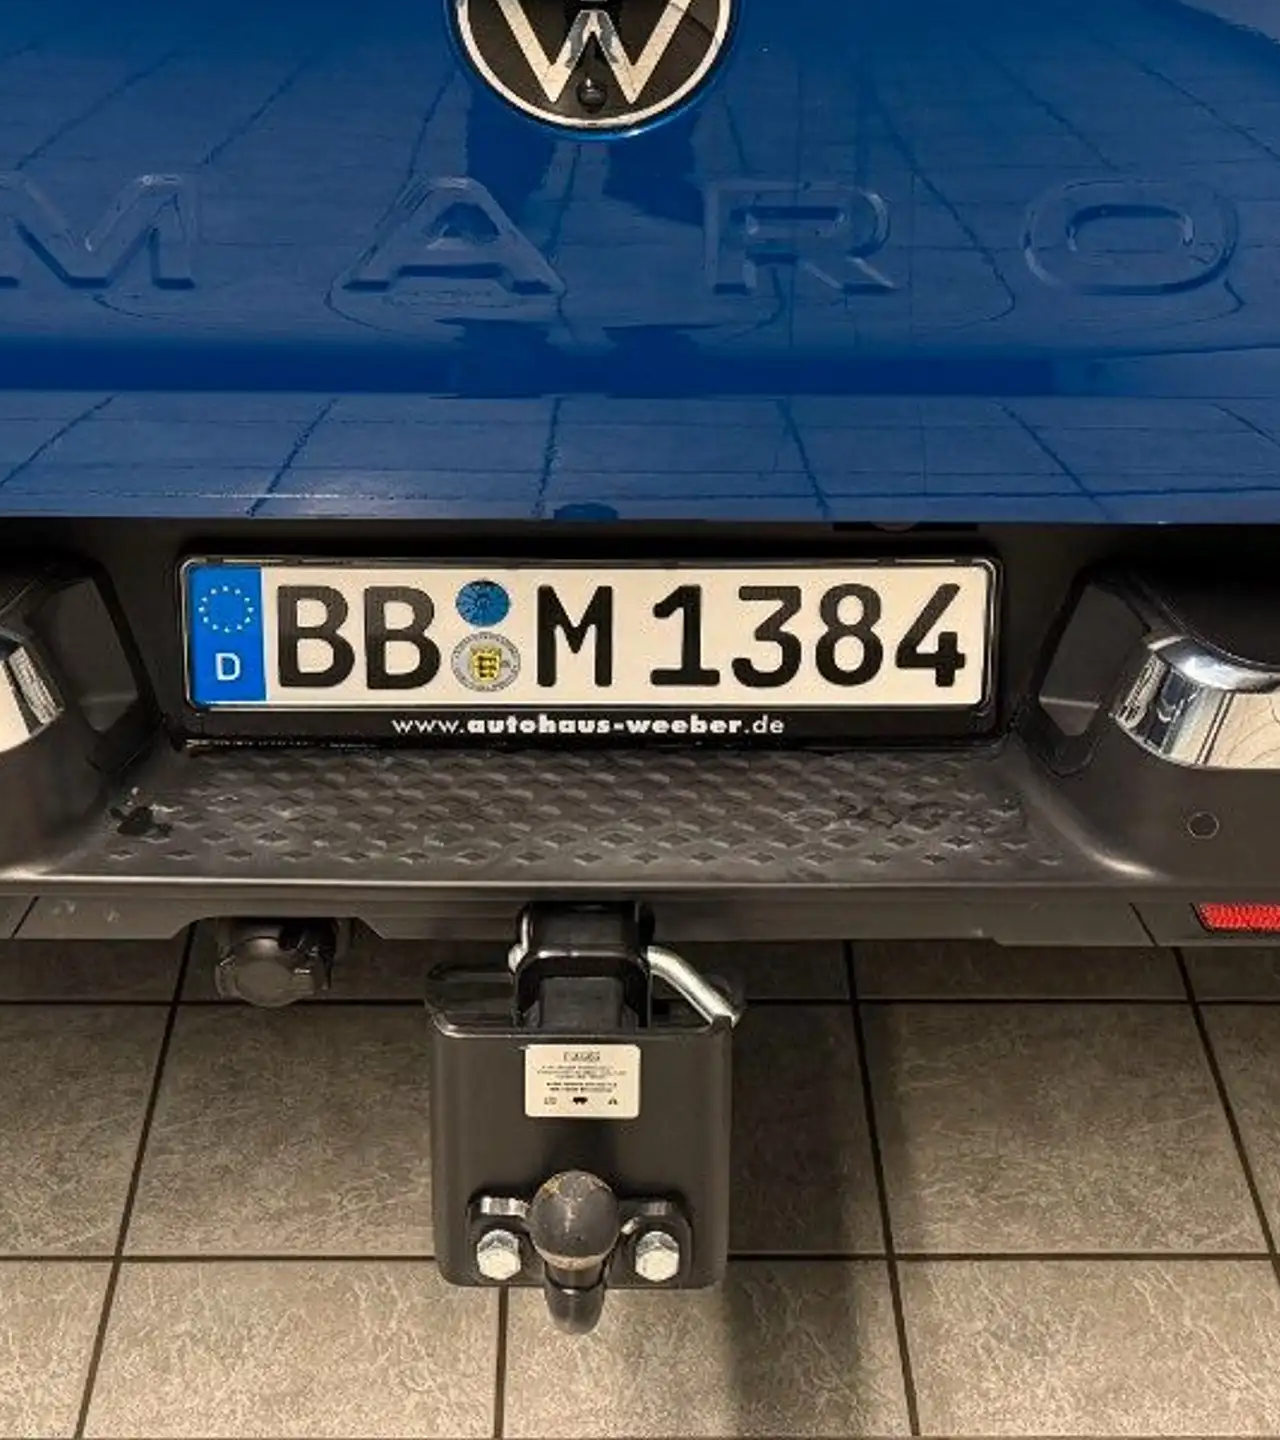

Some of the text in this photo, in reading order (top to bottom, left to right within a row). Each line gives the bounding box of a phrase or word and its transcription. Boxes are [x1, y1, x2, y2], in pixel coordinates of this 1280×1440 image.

[276, 585, 442, 690] BB
[650, 583, 966, 688] 1384
[214, 652, 242, 681] D
[390, 713, 786, 736] www.autohaus-weeber.de
